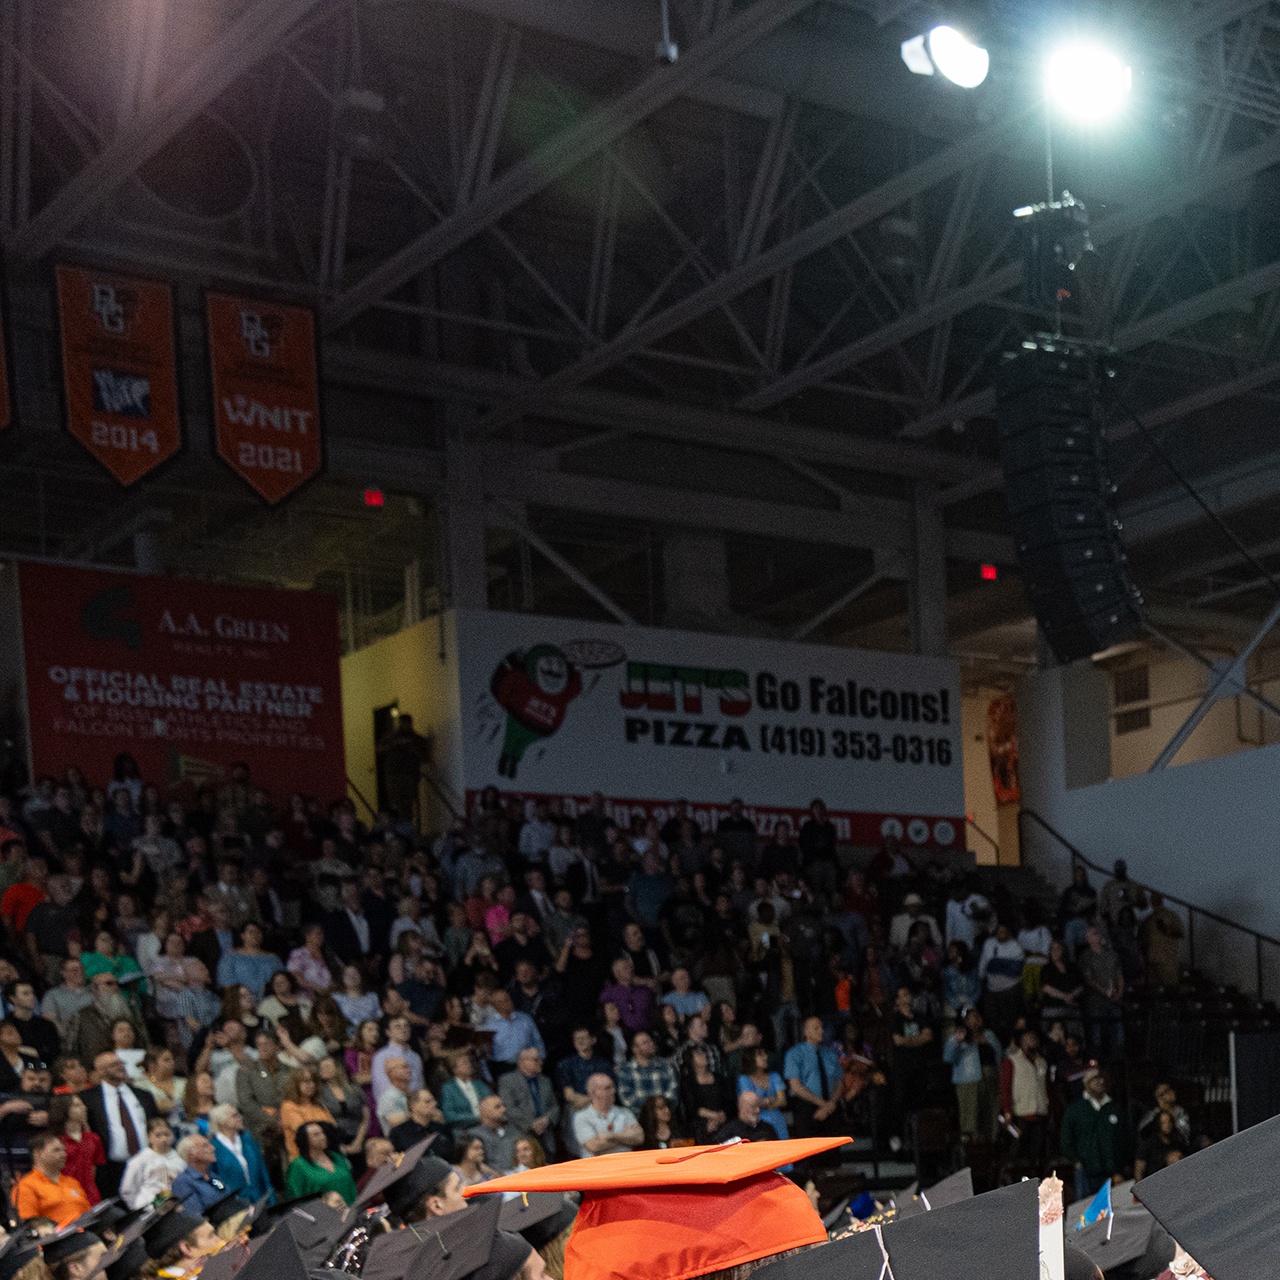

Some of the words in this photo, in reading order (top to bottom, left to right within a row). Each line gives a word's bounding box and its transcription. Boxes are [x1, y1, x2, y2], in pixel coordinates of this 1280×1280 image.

[91, 420, 159, 453] 2014
[238, 441, 304, 472] 2021
[48, 664, 166, 693] OFFICIAL
[170, 675, 235, 698] REAL
[239, 680, 323, 703] ESTATE
[756, 671, 801, 711] Go
[808, 676, 950, 725] Falcons!
[87, 686, 200, 711] HOUSING
[205, 694, 314, 719] PARTNER
[625, 717, 750, 751] PIZZA
[759, 724, 826, 757] (419)
[832, 728, 952, 766] 353-0316
